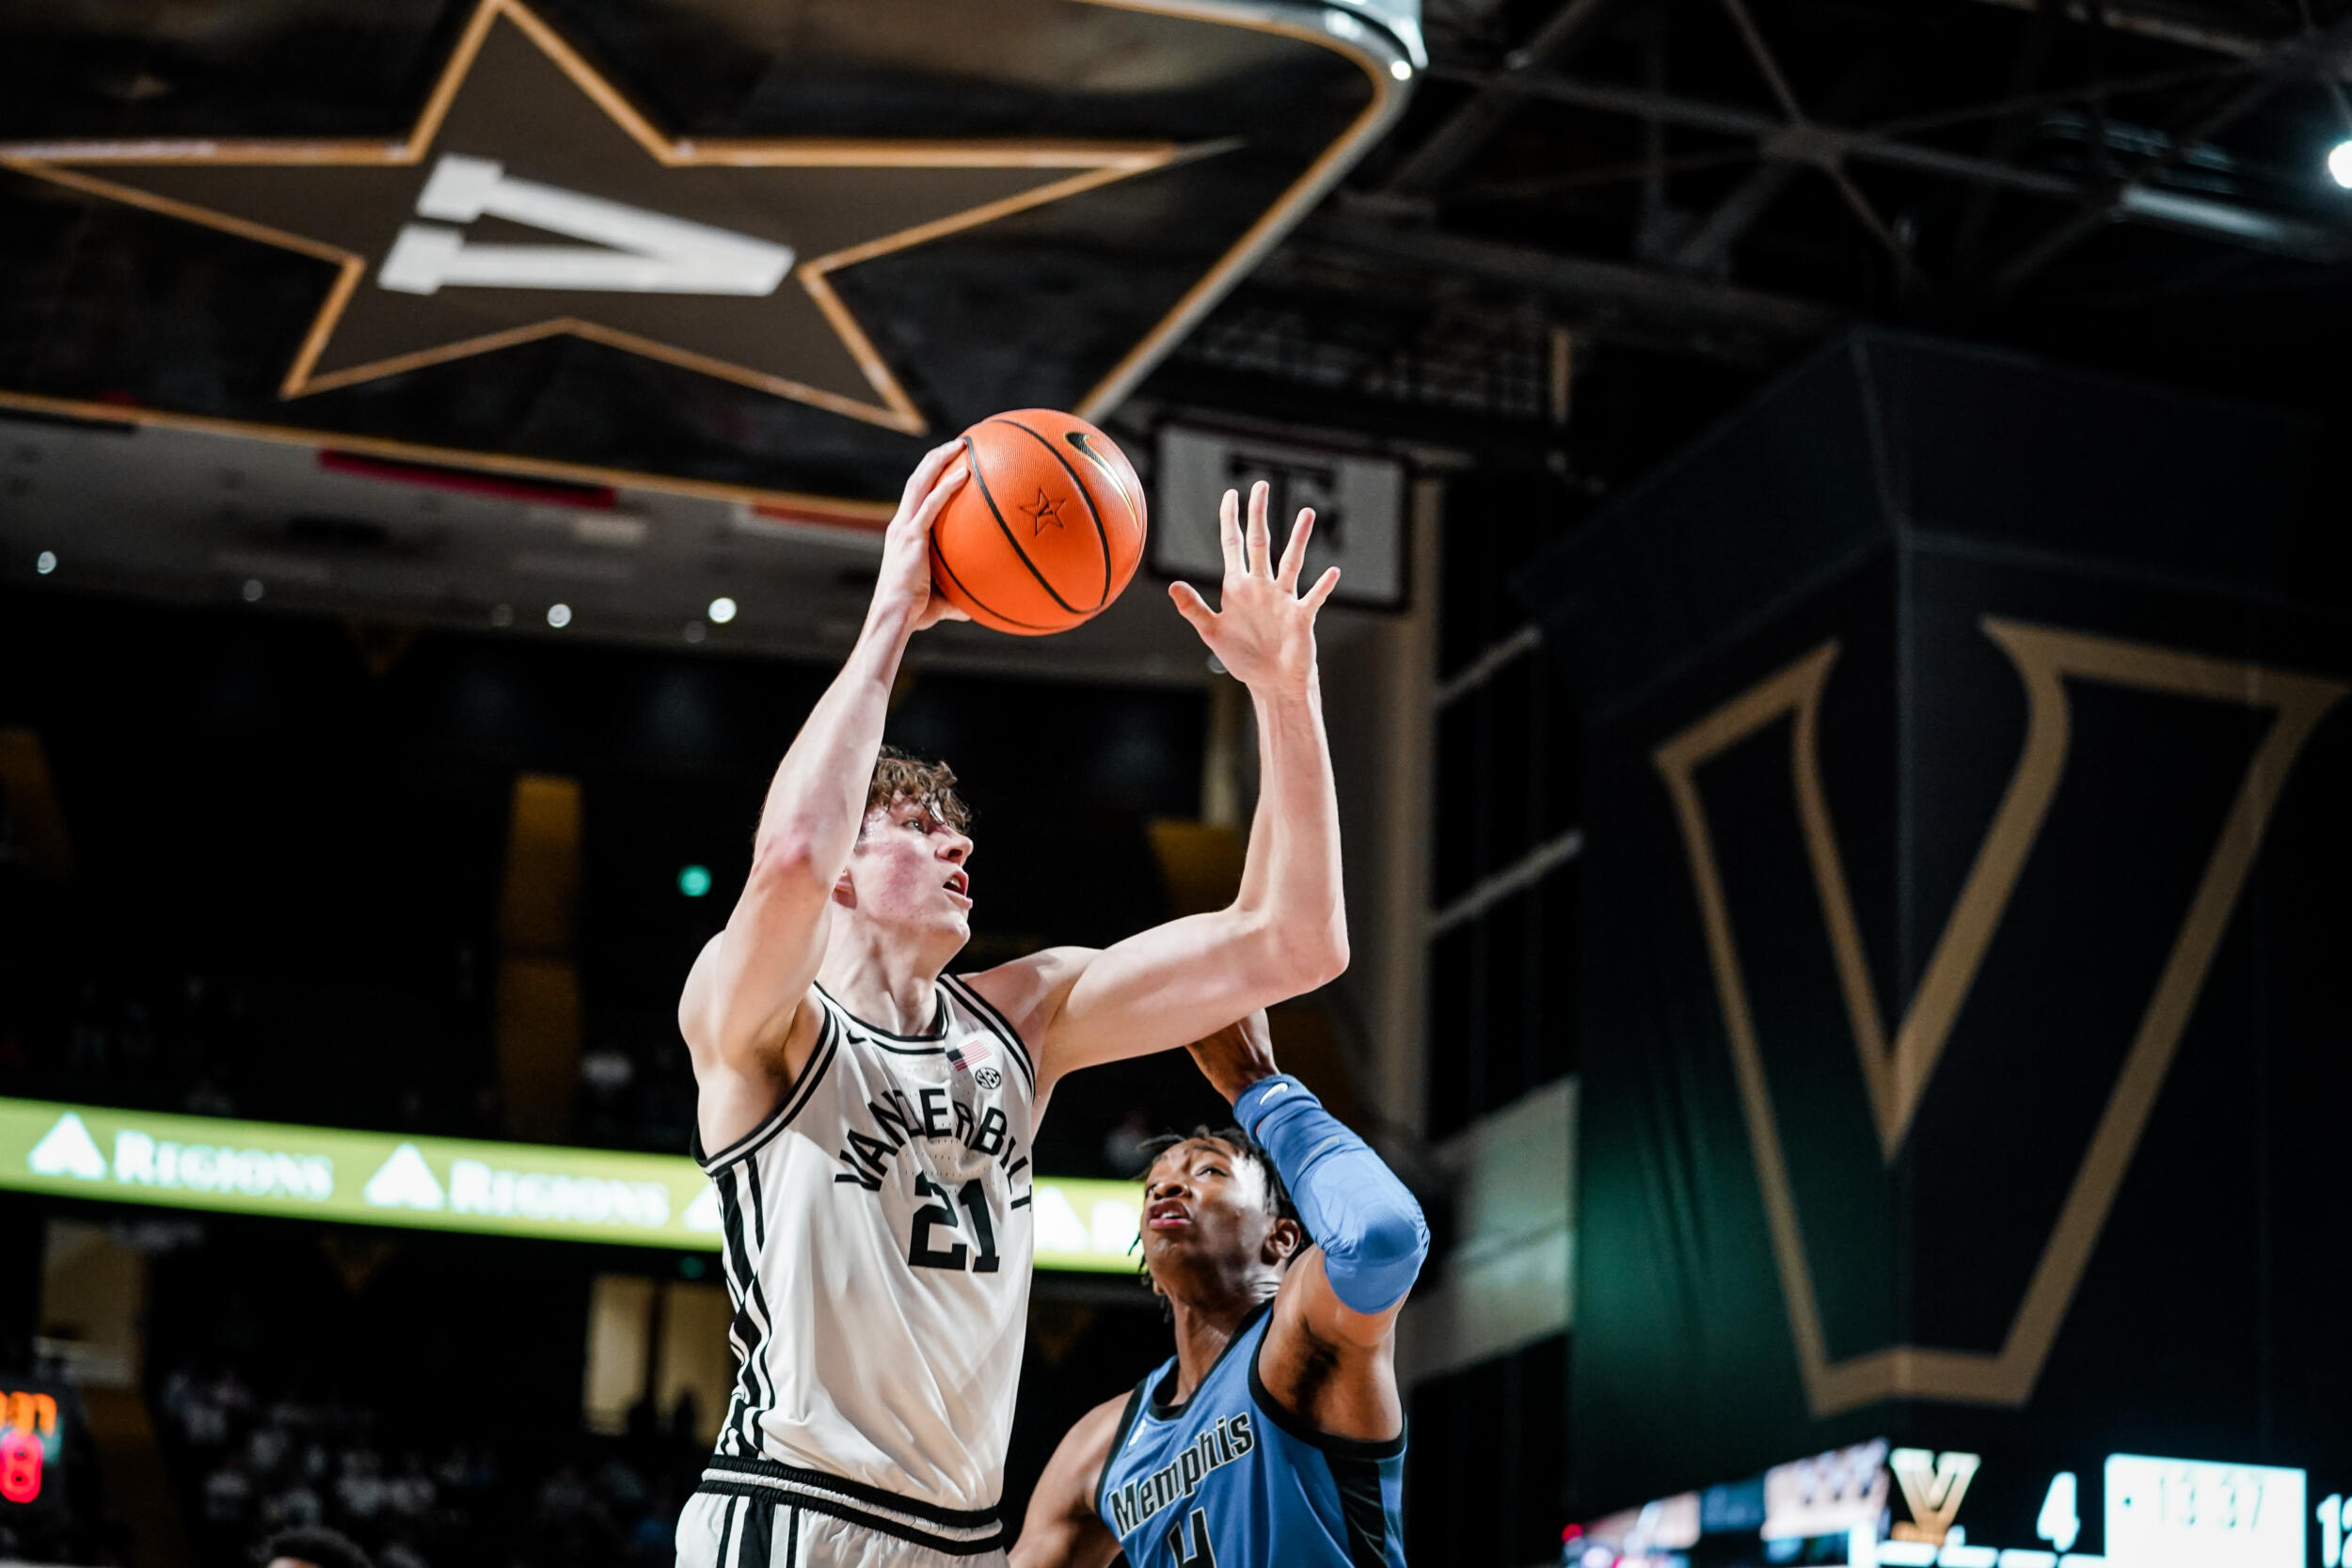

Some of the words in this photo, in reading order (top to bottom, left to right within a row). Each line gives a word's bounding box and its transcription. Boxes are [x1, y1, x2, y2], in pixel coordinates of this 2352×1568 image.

[378, 152, 796, 296] V
[1653, 613, 2351, 1418] V
[976, 1067, 1001, 1089] SEC
[908, 1170, 1000, 1273] 21
[1108, 1412, 1255, 1542] Memphis
[1889, 1447, 1982, 1546] V
[2036, 1470, 2081, 1552] 4
